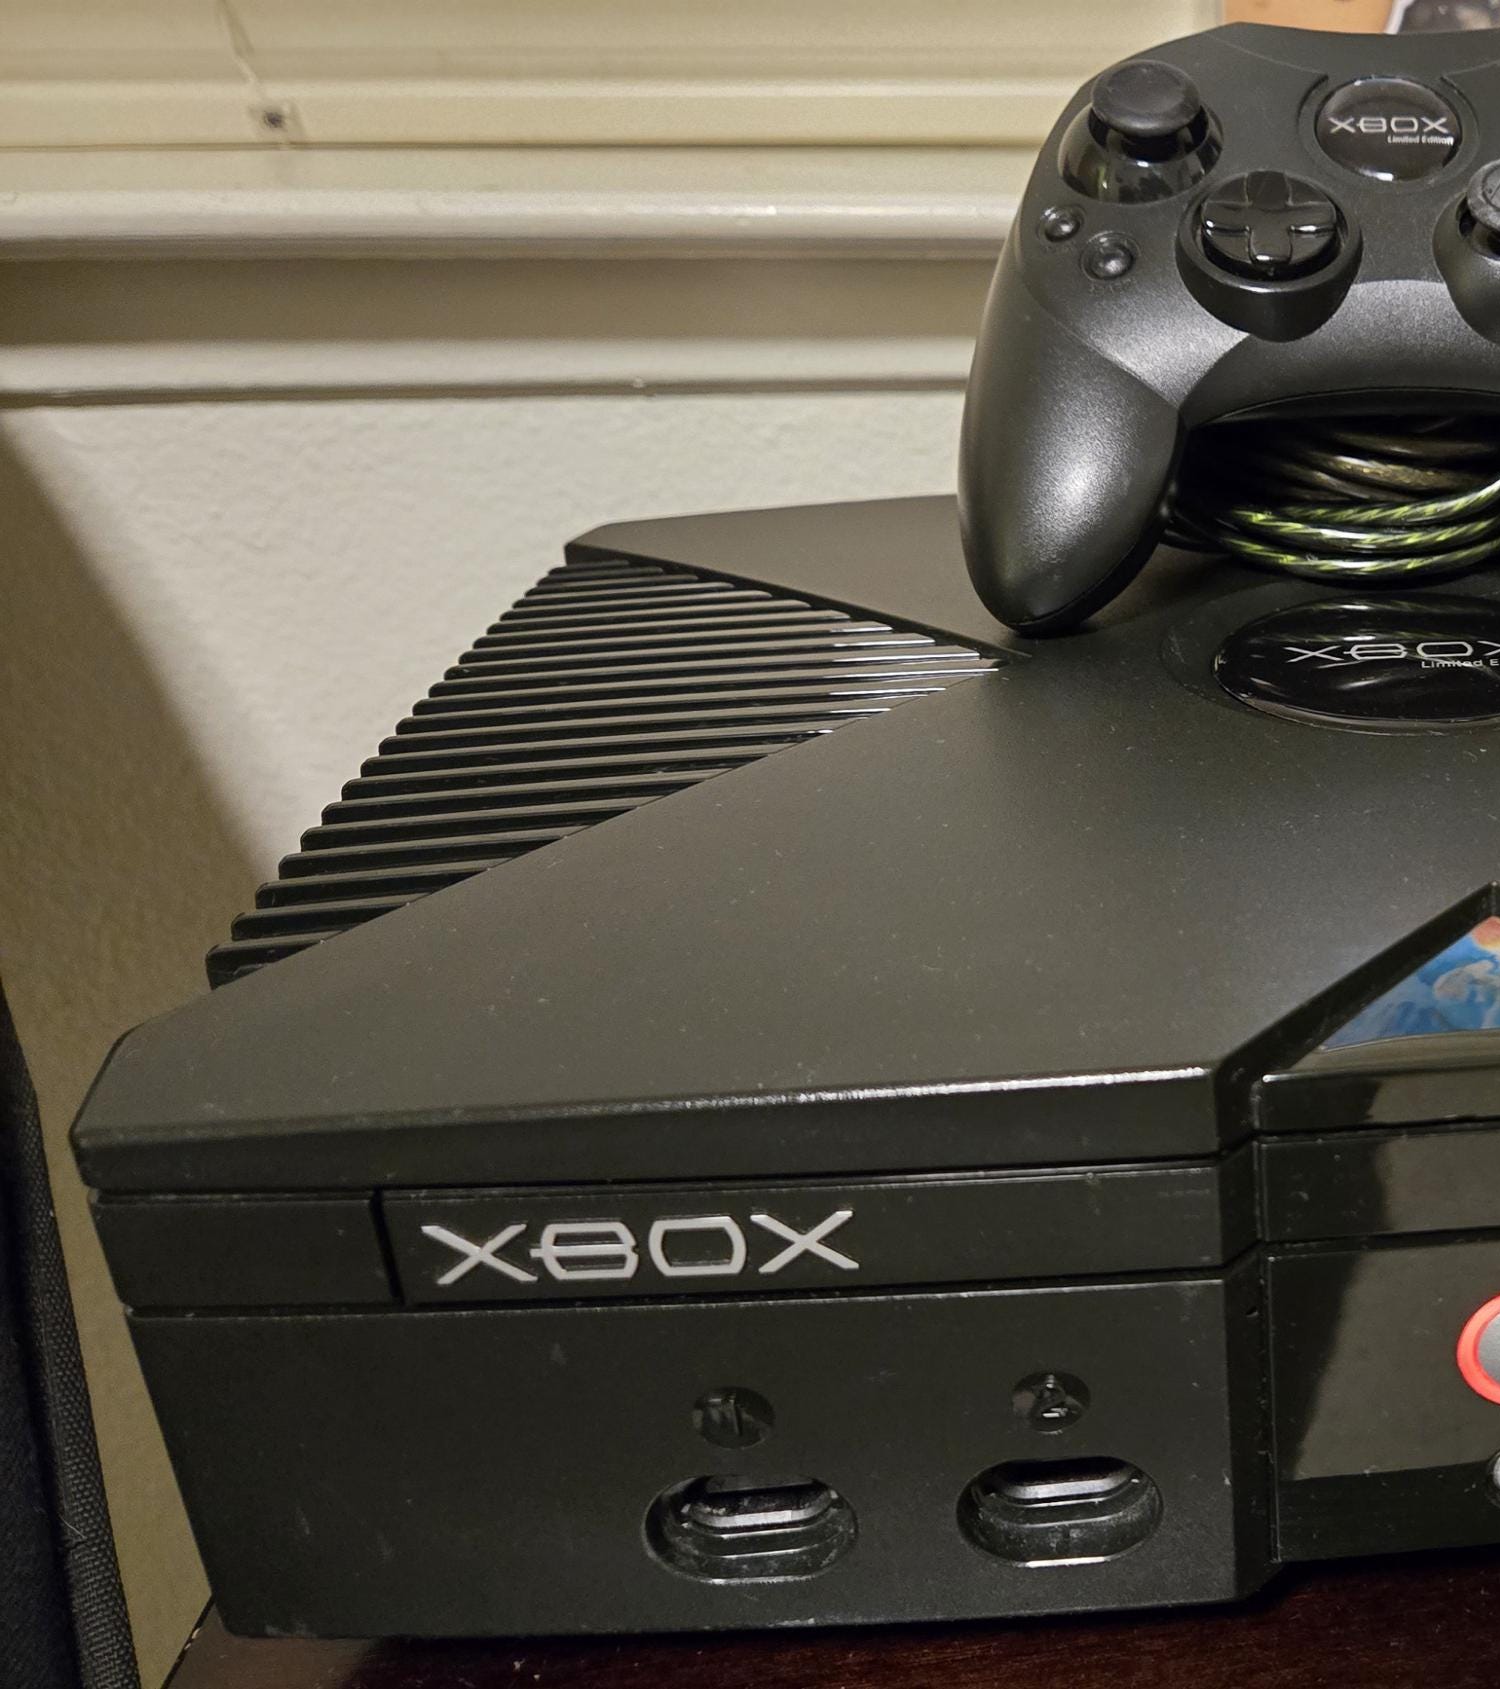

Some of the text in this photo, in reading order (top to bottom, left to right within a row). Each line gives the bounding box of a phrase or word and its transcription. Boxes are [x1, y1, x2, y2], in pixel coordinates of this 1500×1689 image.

[1328, 116, 1449, 133] XBOX
[1387, 134, 1454, 146] Limited Edition
[1421, 660, 1484, 669] Limited
[421, 1210, 860, 1286] XBOX
